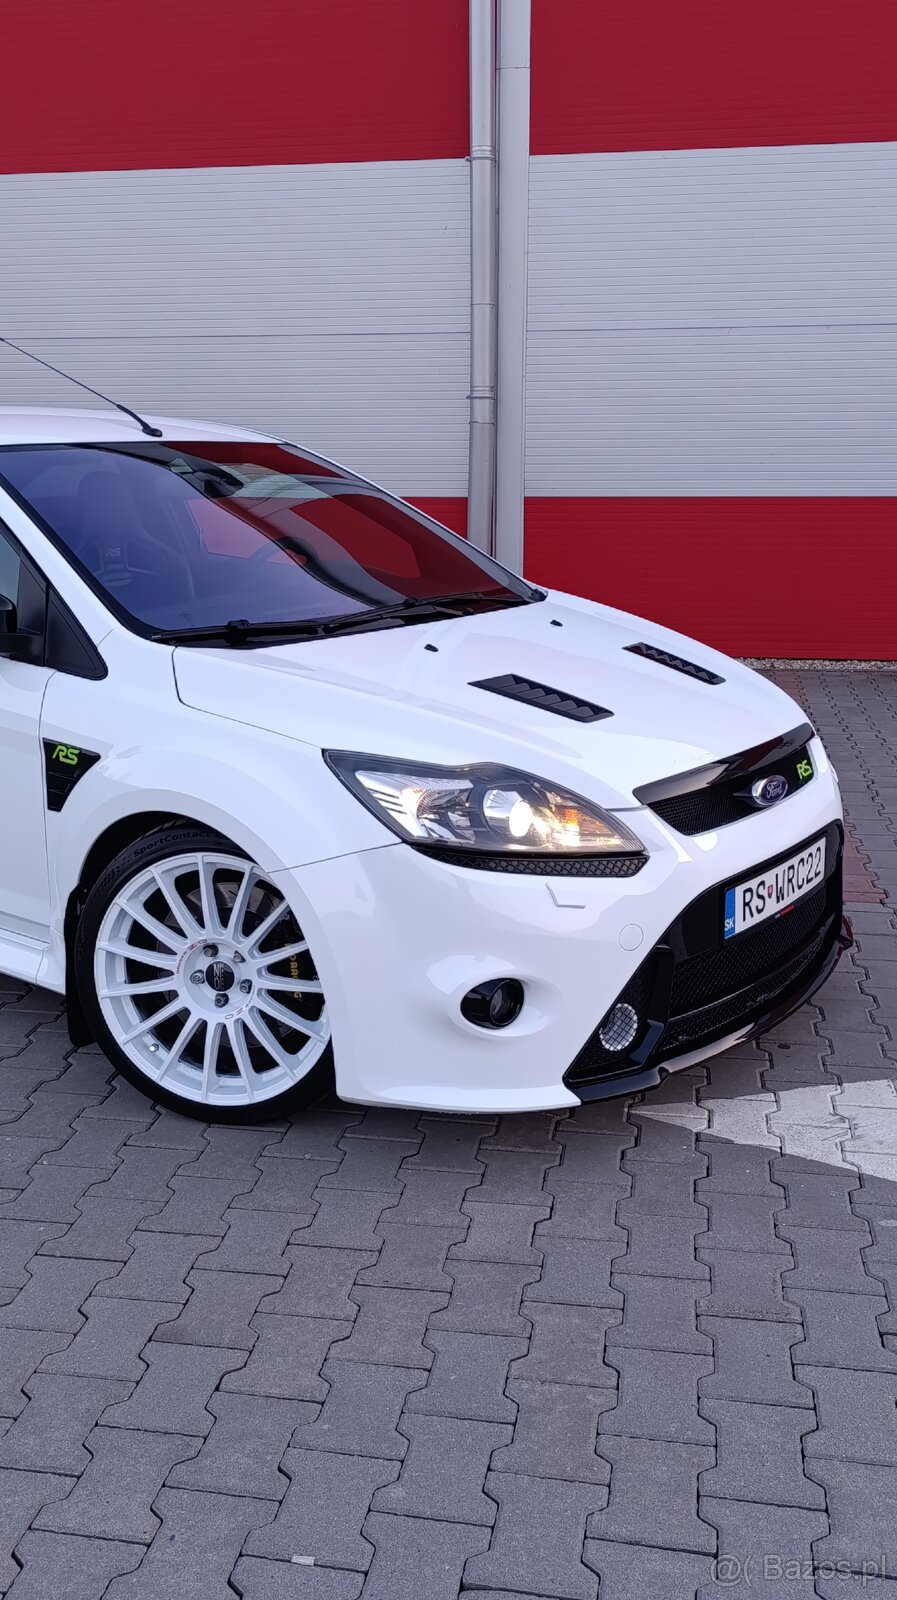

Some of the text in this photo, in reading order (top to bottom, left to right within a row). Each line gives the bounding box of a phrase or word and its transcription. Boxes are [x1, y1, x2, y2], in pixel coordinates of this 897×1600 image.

[52, 744, 80, 765] RS
[796, 759, 812, 779] RS
[766, 781, 783, 799] Ford
[133, 830, 210, 858] SportContact
[742, 846, 821, 922] RS WRC22
[724, 917, 735, 931] SK
